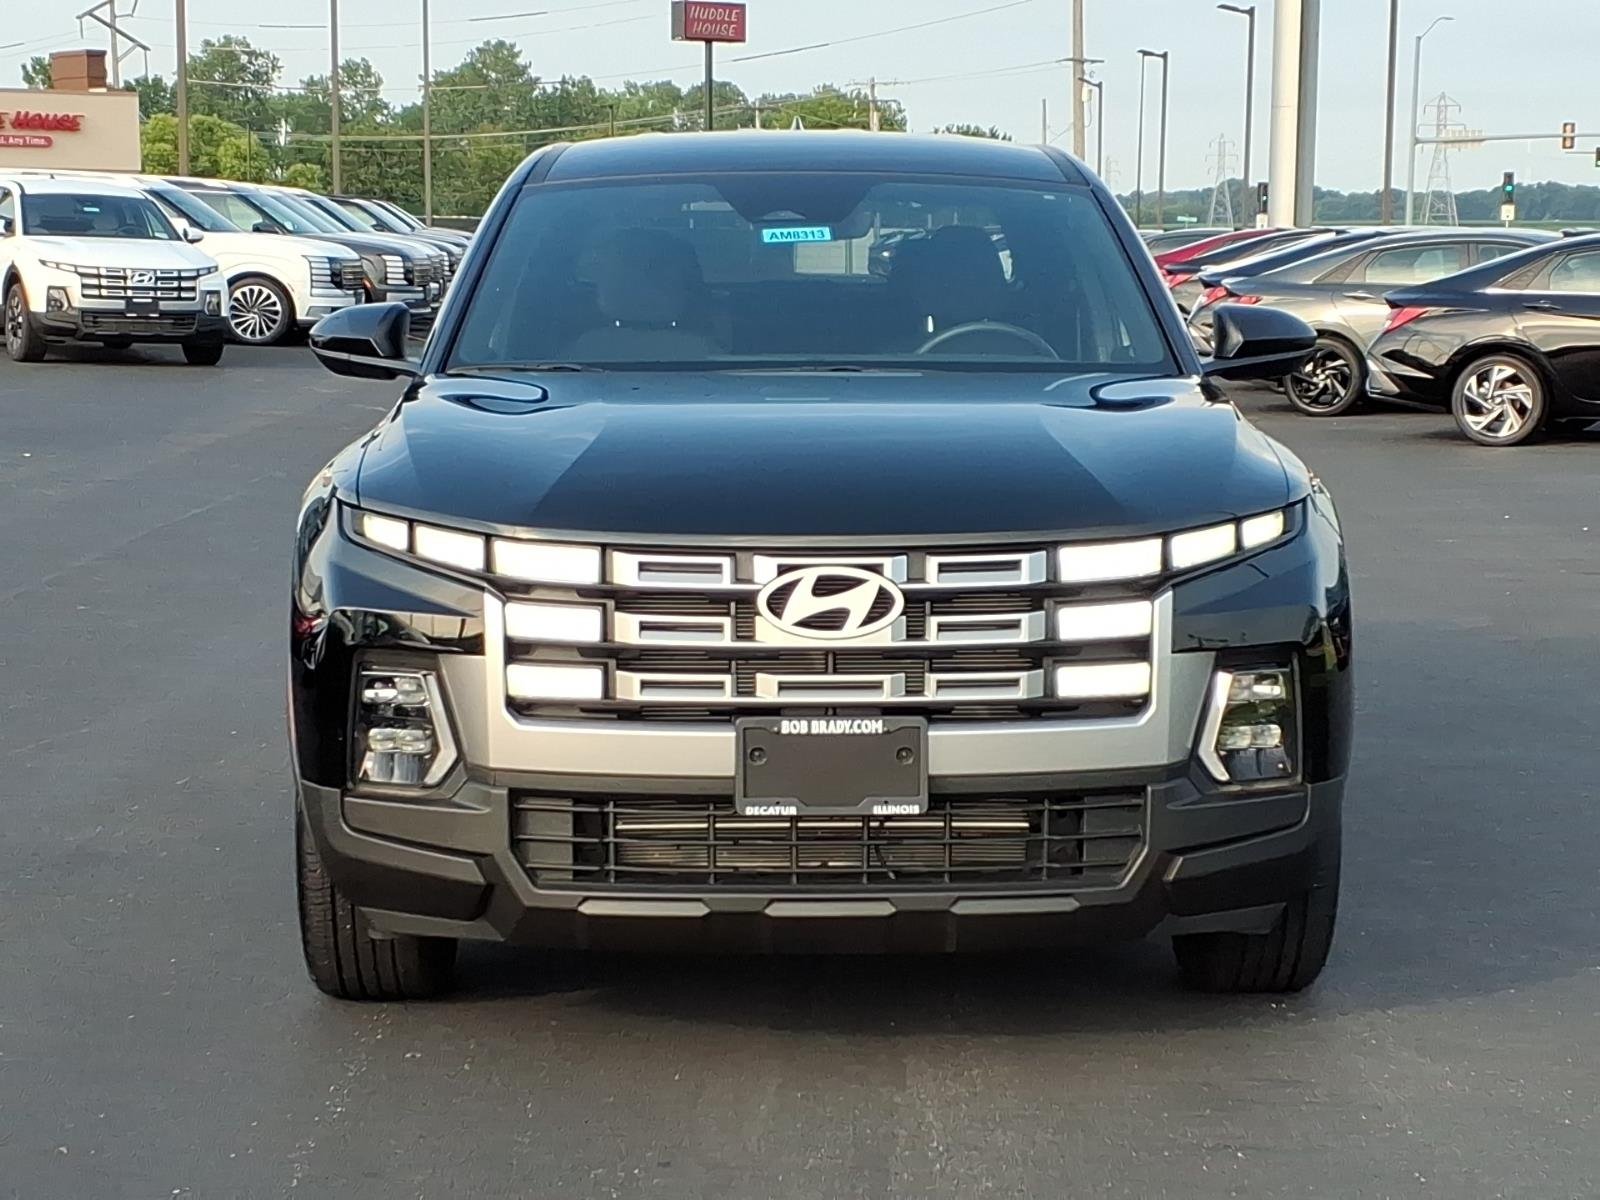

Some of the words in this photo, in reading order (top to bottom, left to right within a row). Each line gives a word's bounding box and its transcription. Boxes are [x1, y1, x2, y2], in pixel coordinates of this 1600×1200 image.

[690, 5, 740, 21] HUDDLE
[693, 22, 737, 36] HOUSE
[8, 136, 23, 145] Any
[769, 229, 825, 240] AM8313
[781, 720, 808, 734] BOB
[811, 720, 883, 734] BRADY.COM
[745, 806, 797, 816] DECATUR
[873, 804, 920, 815] ILLINOIS
